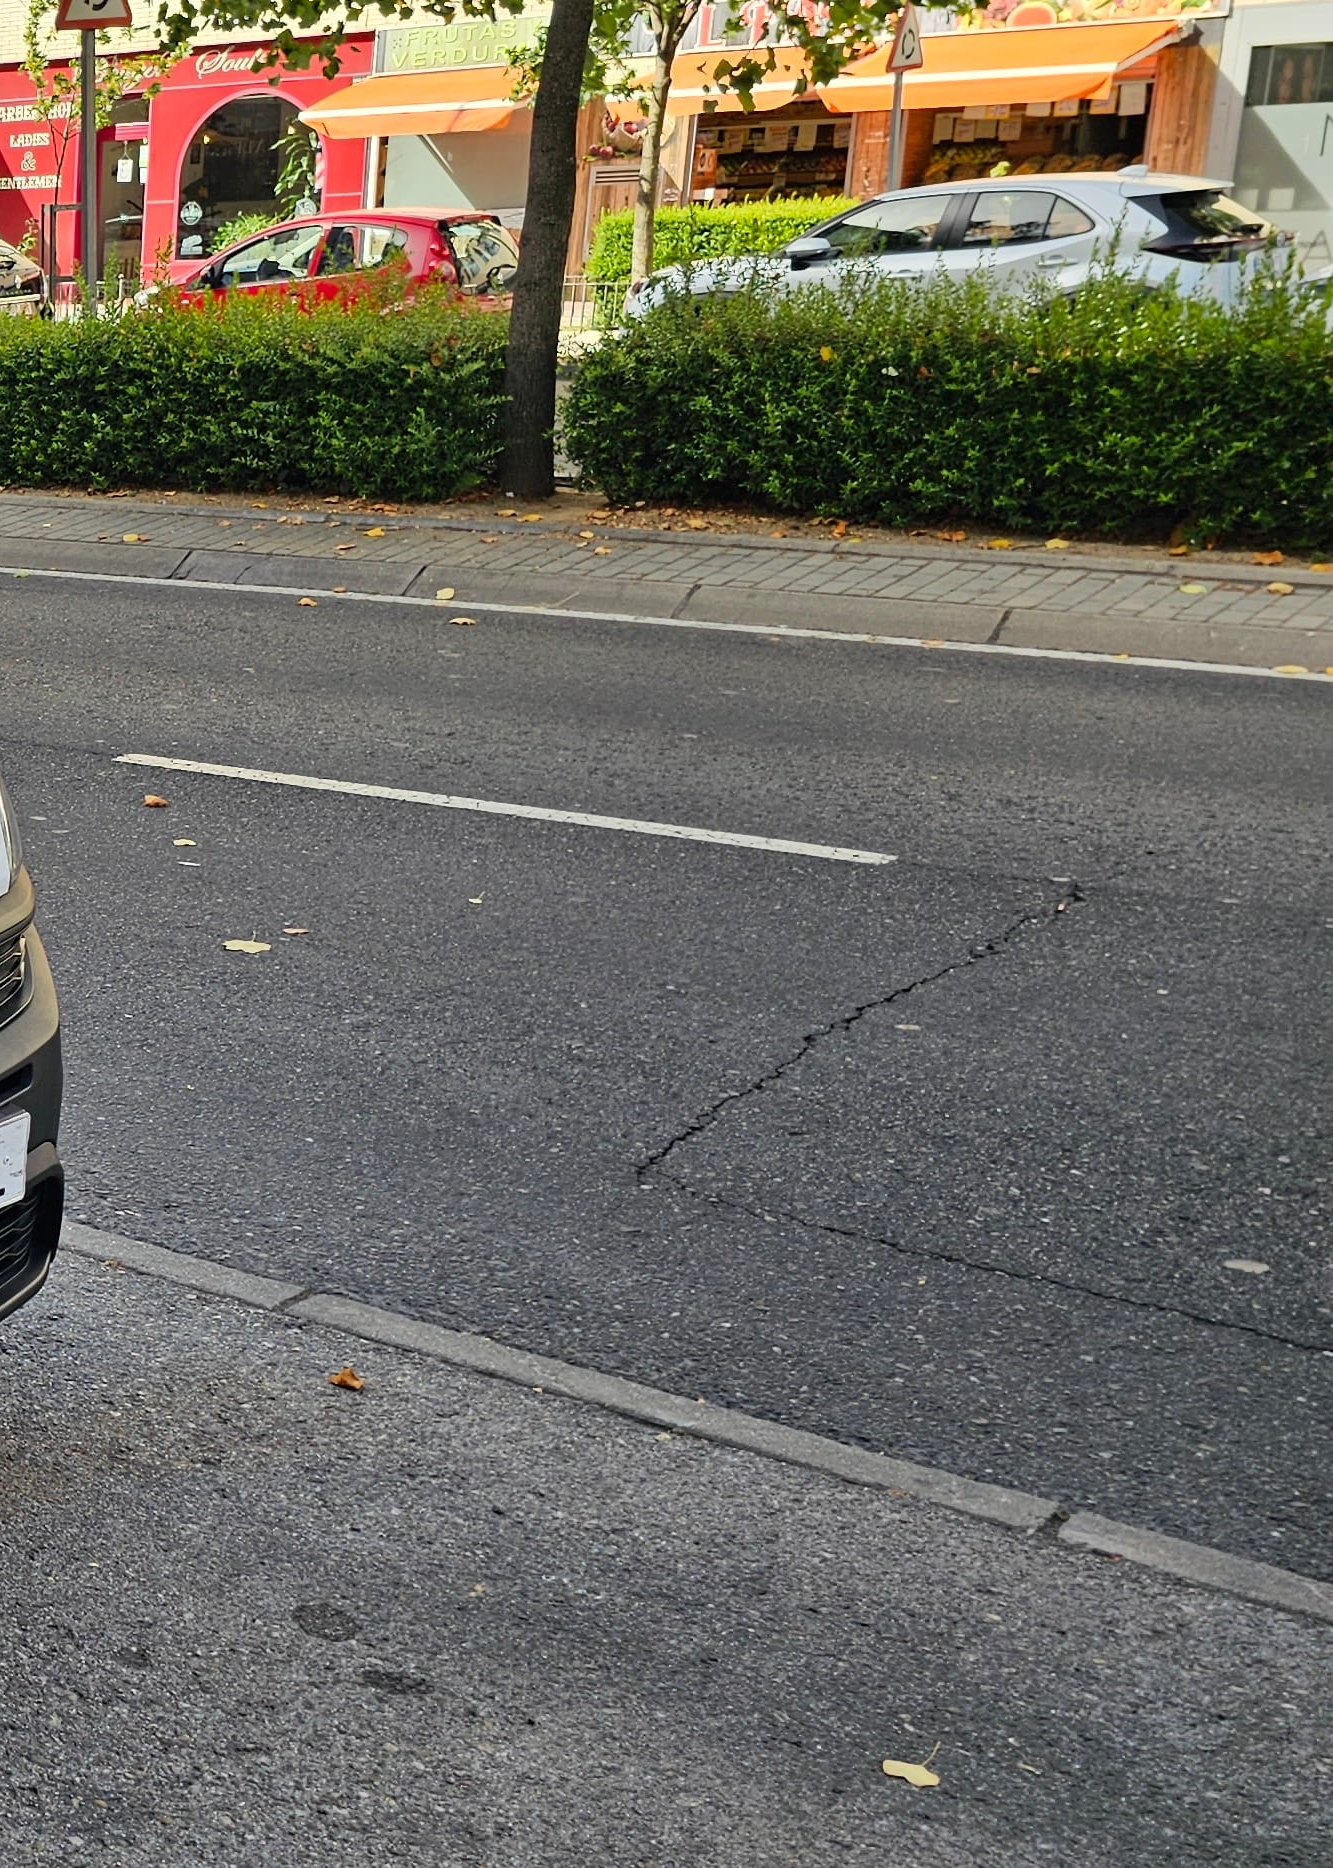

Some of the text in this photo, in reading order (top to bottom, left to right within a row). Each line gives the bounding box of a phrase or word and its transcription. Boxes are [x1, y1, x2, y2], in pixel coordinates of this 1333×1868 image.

[405, 20, 518, 47] FRUTAS
[391, 44, 511, 69] VERDUR
[8, 133, 51, 148] LADIES
[20, 151, 37, 172] &
